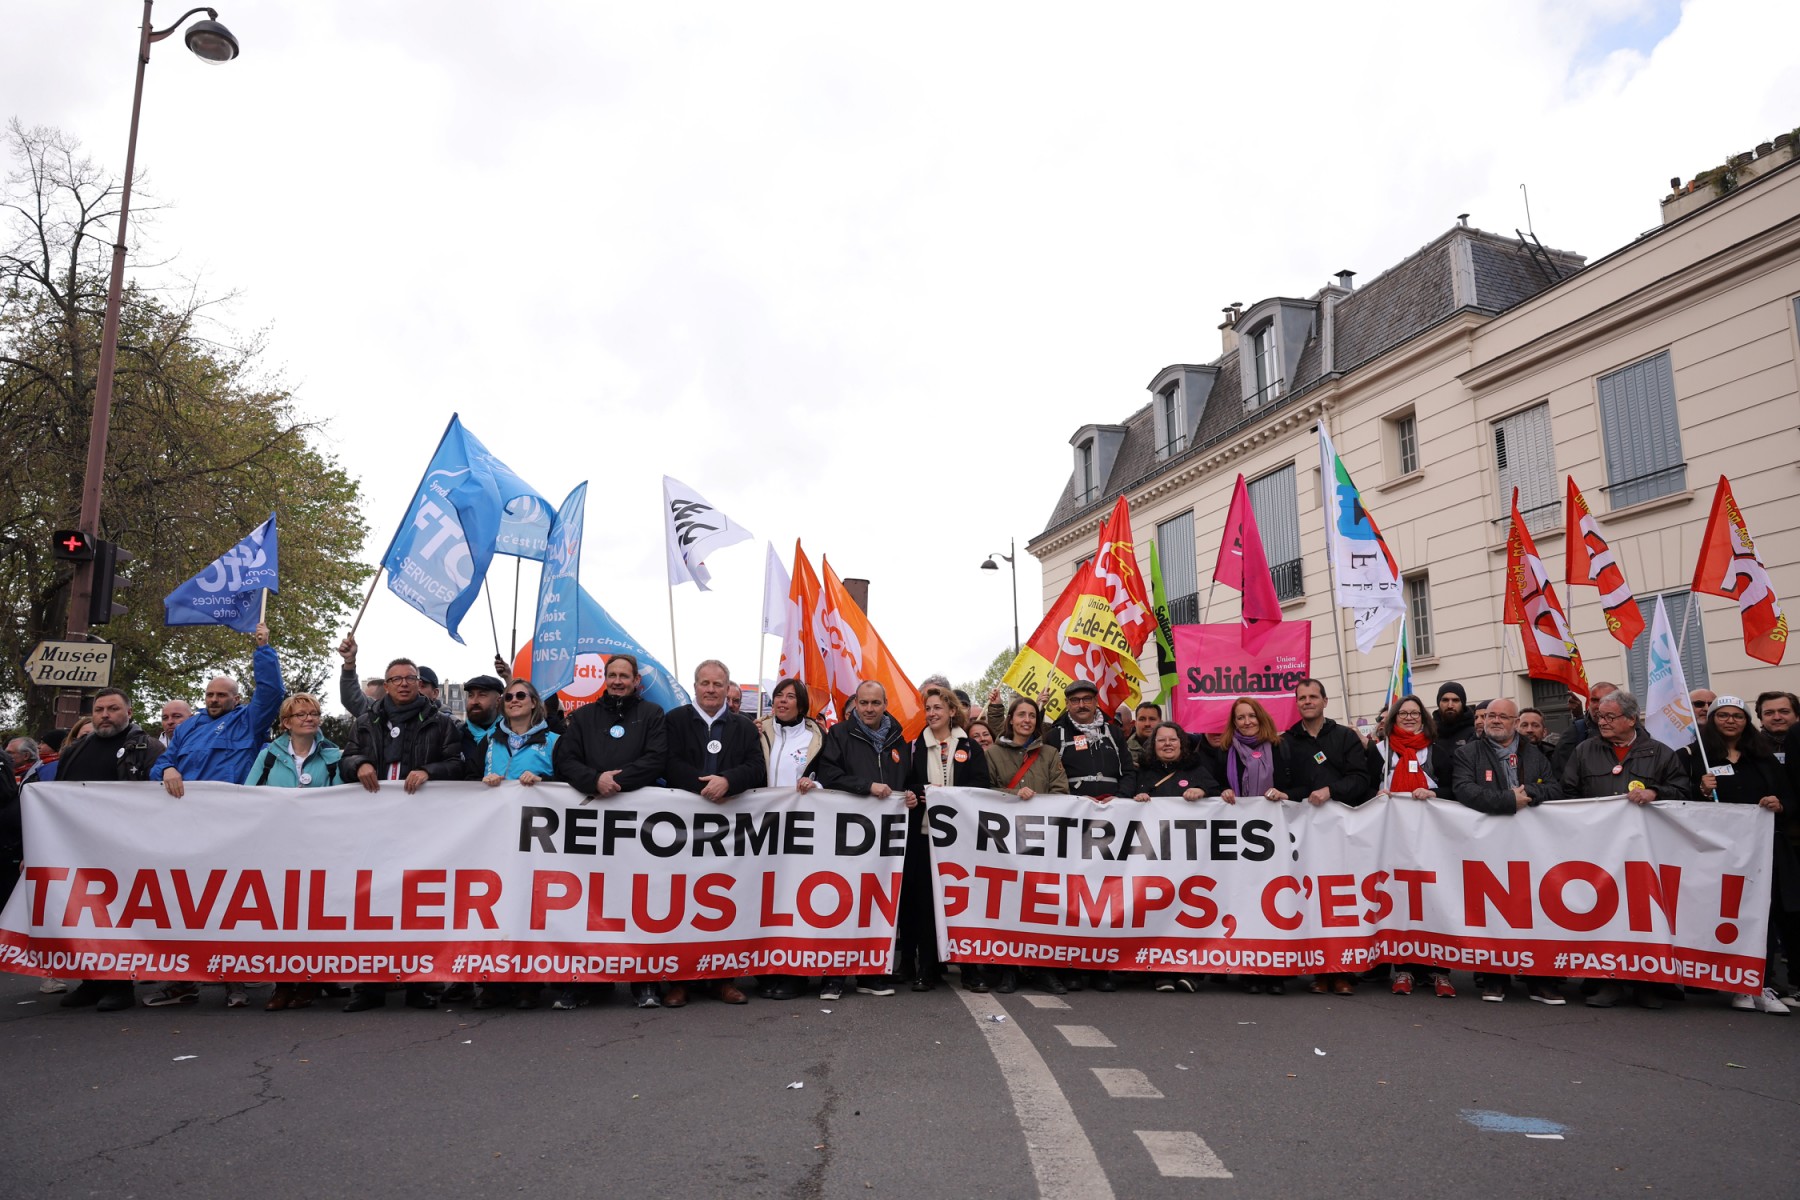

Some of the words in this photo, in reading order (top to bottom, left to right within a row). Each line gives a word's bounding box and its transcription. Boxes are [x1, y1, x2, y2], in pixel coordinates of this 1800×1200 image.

[415, 494, 475, 591] FTC
[400, 556, 455, 603] SERVICES
[1088, 597, 1110, 613] Union
[539, 629, 562, 643] c'est
[578, 637, 594, 645] on
[597, 637, 634, 650] choix
[39, 646, 107, 663] Musée
[37, 665, 97, 681] Rodin
[574, 664, 602, 679] fdt:
[1276, 662, 1306, 671] syndicale
[1047, 670, 1068, 690] Unio
[976, 810, 1276, 862] RETRAITES
[25, 867, 503, 931] TRAVAILLER
[529, 869, 737, 934] PLUS
[1260, 869, 1436, 931] C'EST
[1462, 860, 1682, 936] NON
[1714, 874, 1745, 945] !
[207, 954, 434, 974] #PAS1JOURDEPLUS
[451, 954, 679, 974] #PAS1JOURDEPLUS
[696, 948, 891, 971] #PAS1JOURDEPLU
[948, 938, 1120, 963] AS1JOURDEPLUS
[1135, 947, 1325, 968] #PAS1JOURDEPLUS
[1341, 940, 1535, 968] #PAS1JOURDEPLUS
[1553, 952, 1760, 988] #PAS1JOUEPLUS
